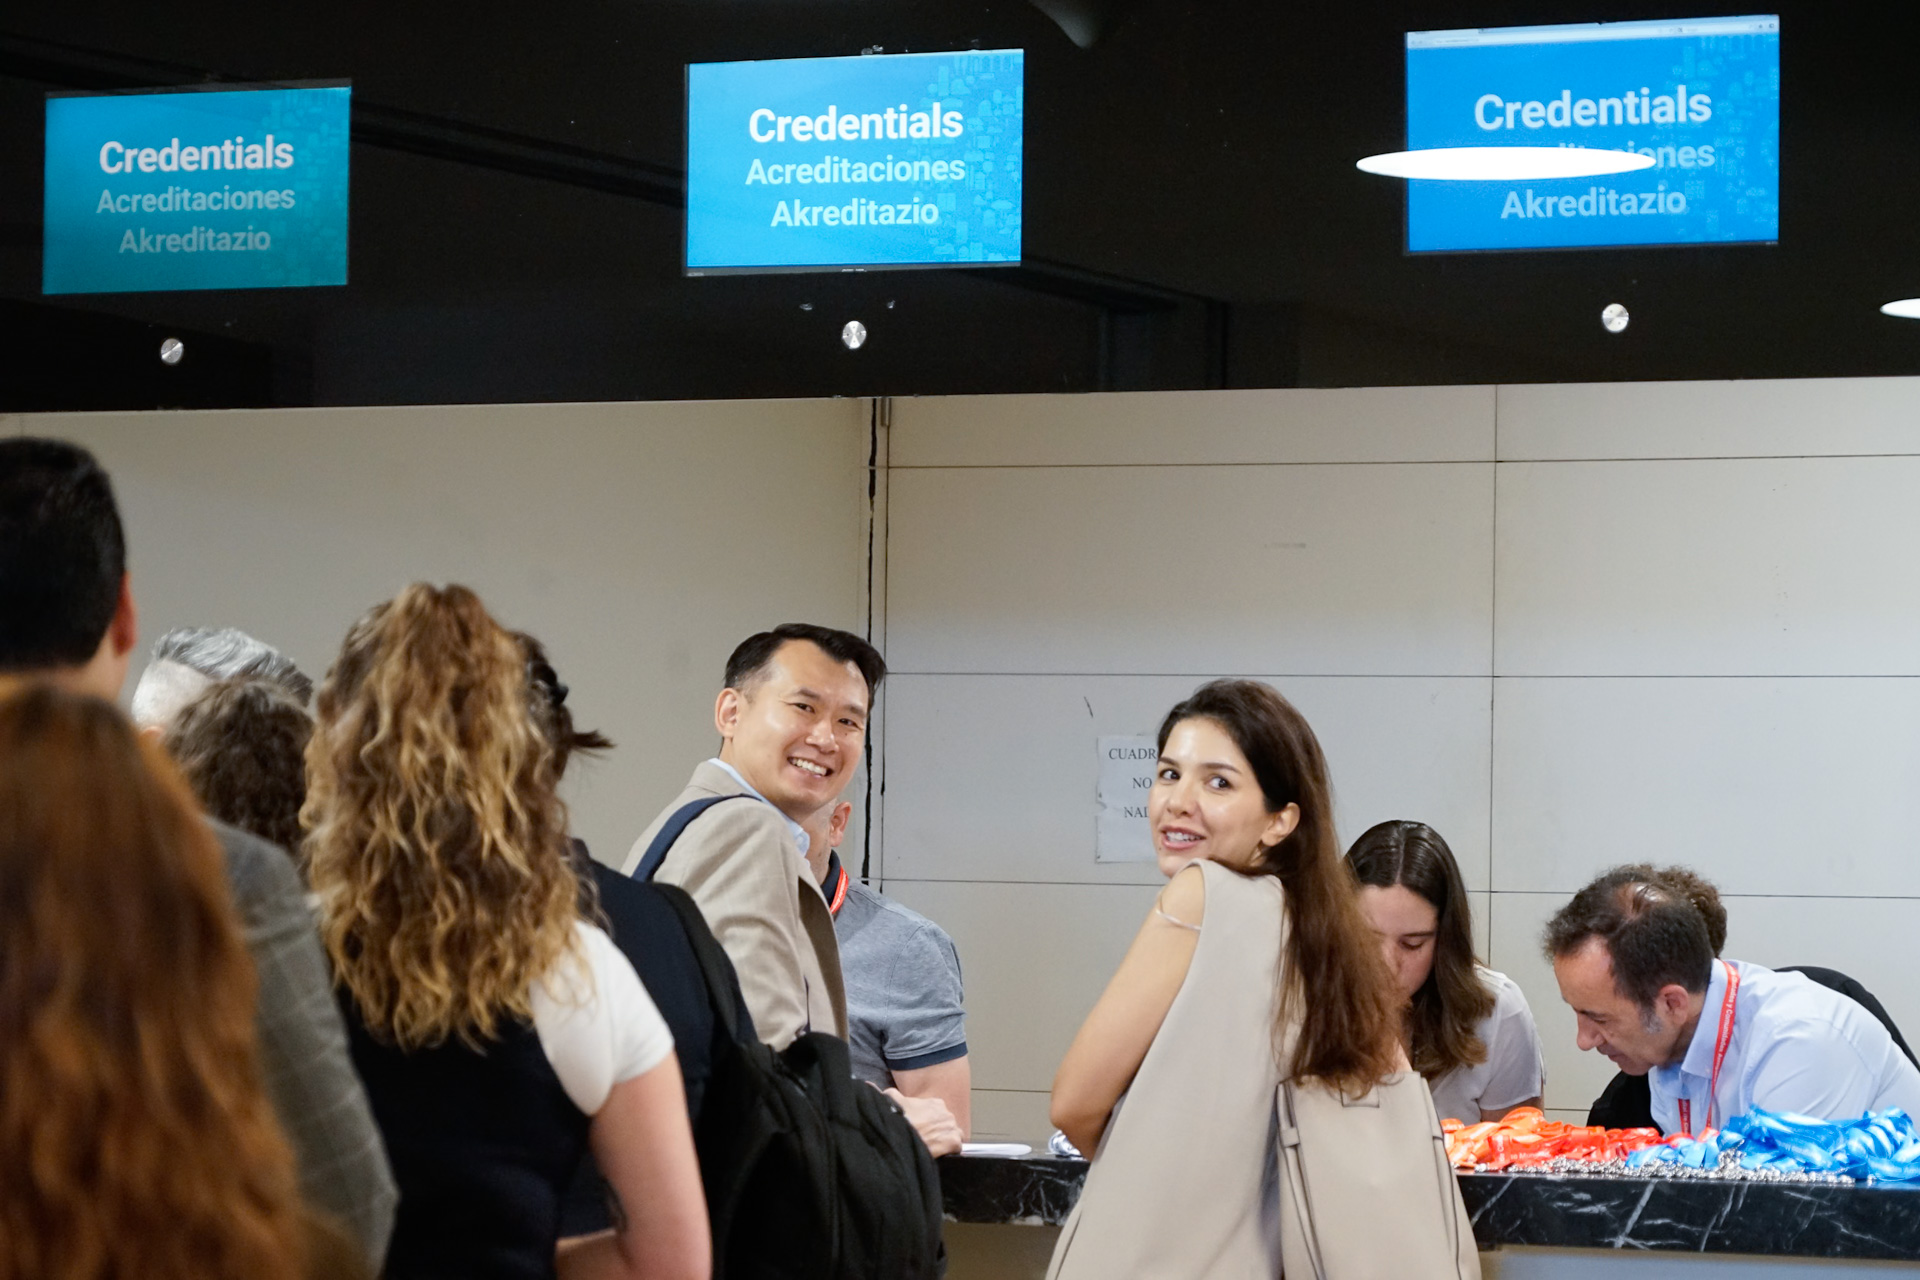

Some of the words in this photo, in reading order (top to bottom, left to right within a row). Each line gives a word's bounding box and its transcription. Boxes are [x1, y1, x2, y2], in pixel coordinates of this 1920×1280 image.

[749, 102, 964, 143] Credentials
[1474, 84, 1712, 131] Credentials
[99, 134, 294, 174] Credentials
[745, 154, 966, 185] Acreditaciones
[96, 185, 296, 214] Acreditaciones
[770, 196, 939, 227] Akreditazio
[1500, 184, 1687, 219] Akreditazio
[119, 225, 271, 253] Akreditazio
[1108, 748, 1157, 760] CUADR
[1132, 777, 1153, 789] NO
